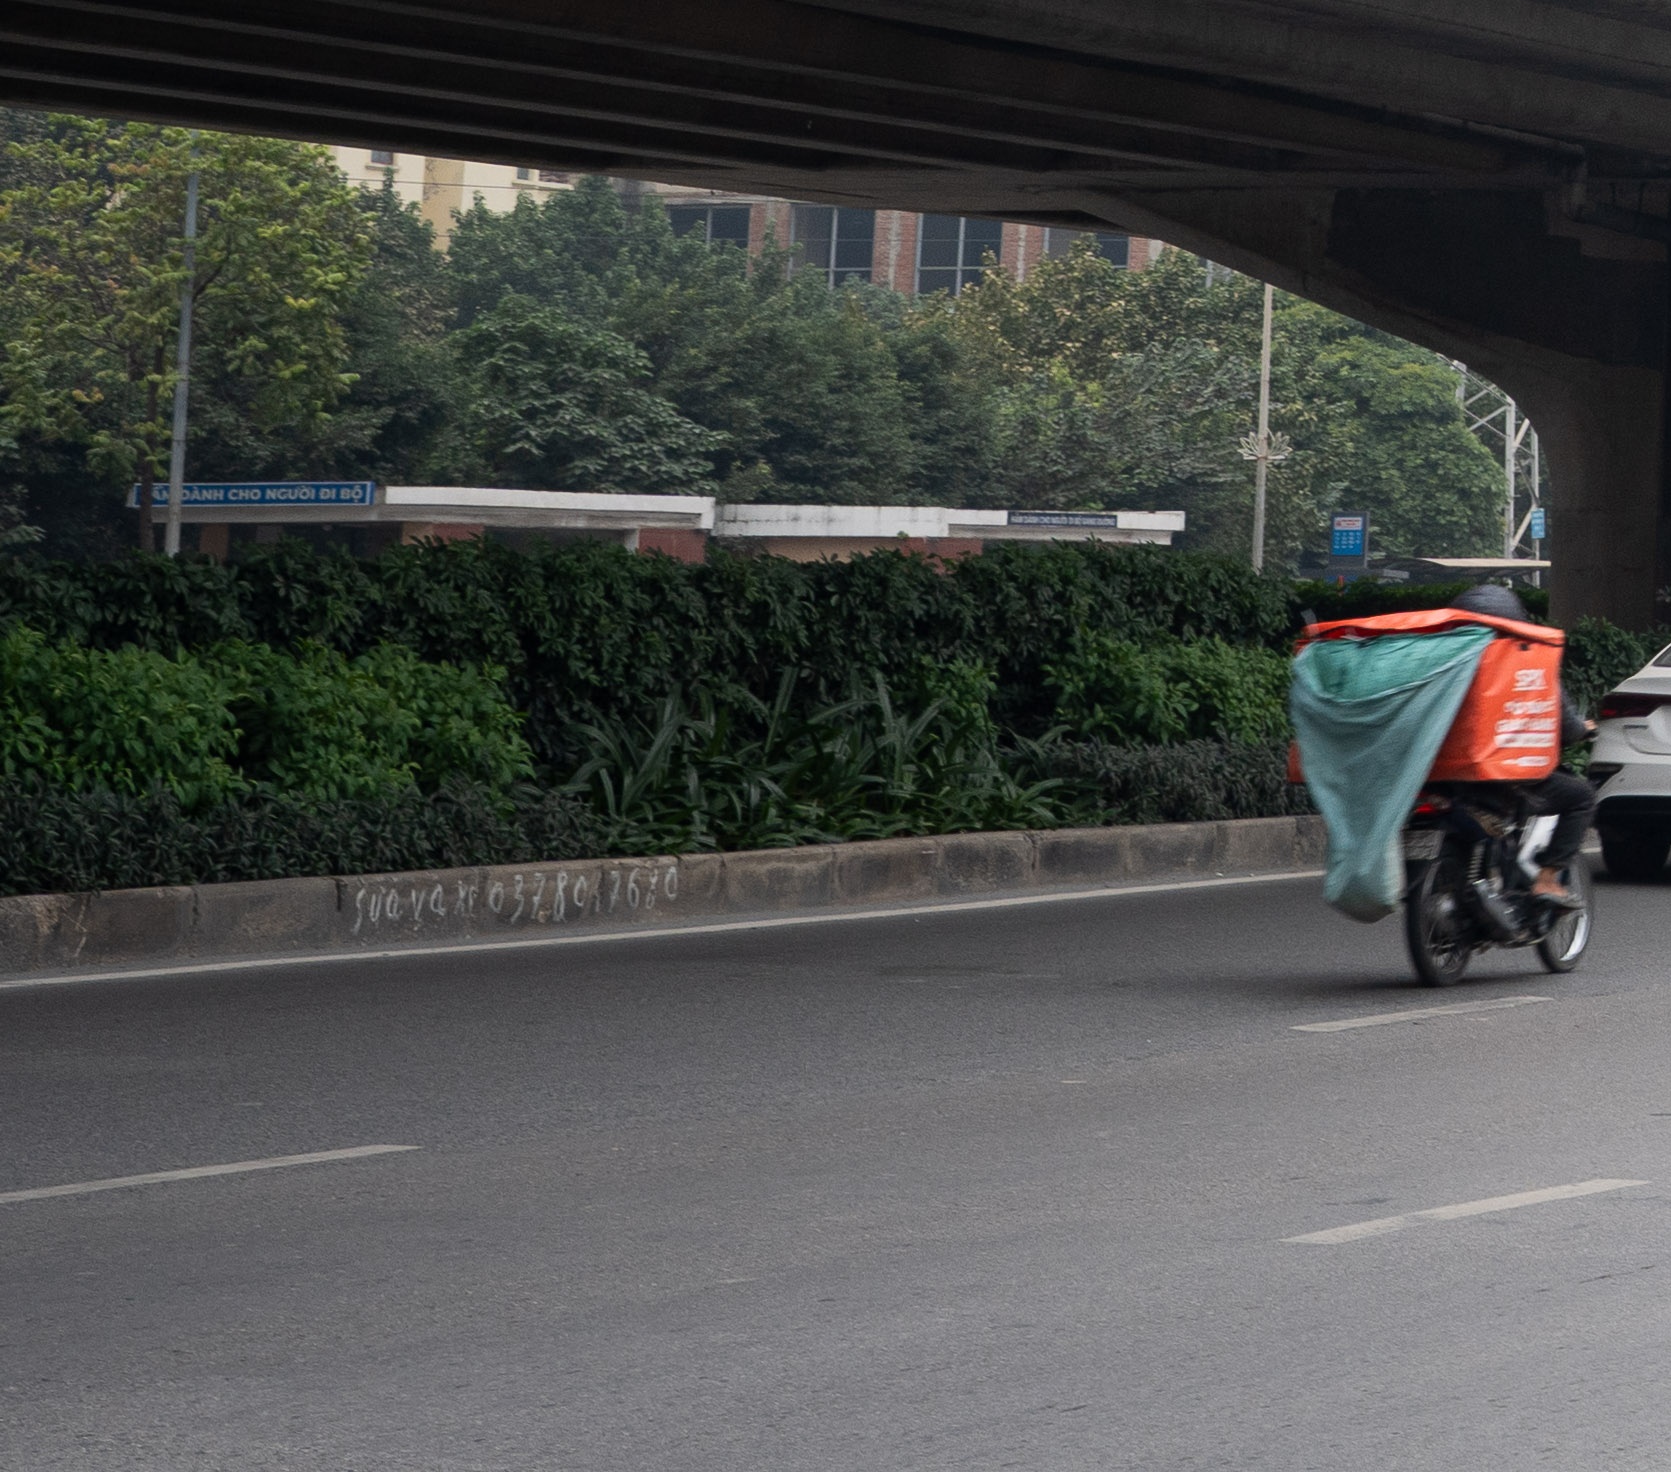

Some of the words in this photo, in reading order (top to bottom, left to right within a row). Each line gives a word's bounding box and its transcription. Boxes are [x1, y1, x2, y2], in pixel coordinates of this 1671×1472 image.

[227, 488, 261, 500] CHO
[266, 484, 315, 500] NGƯỜI
[319, 487, 336, 499] ĐI
[340, 485, 363, 503] BỘ
